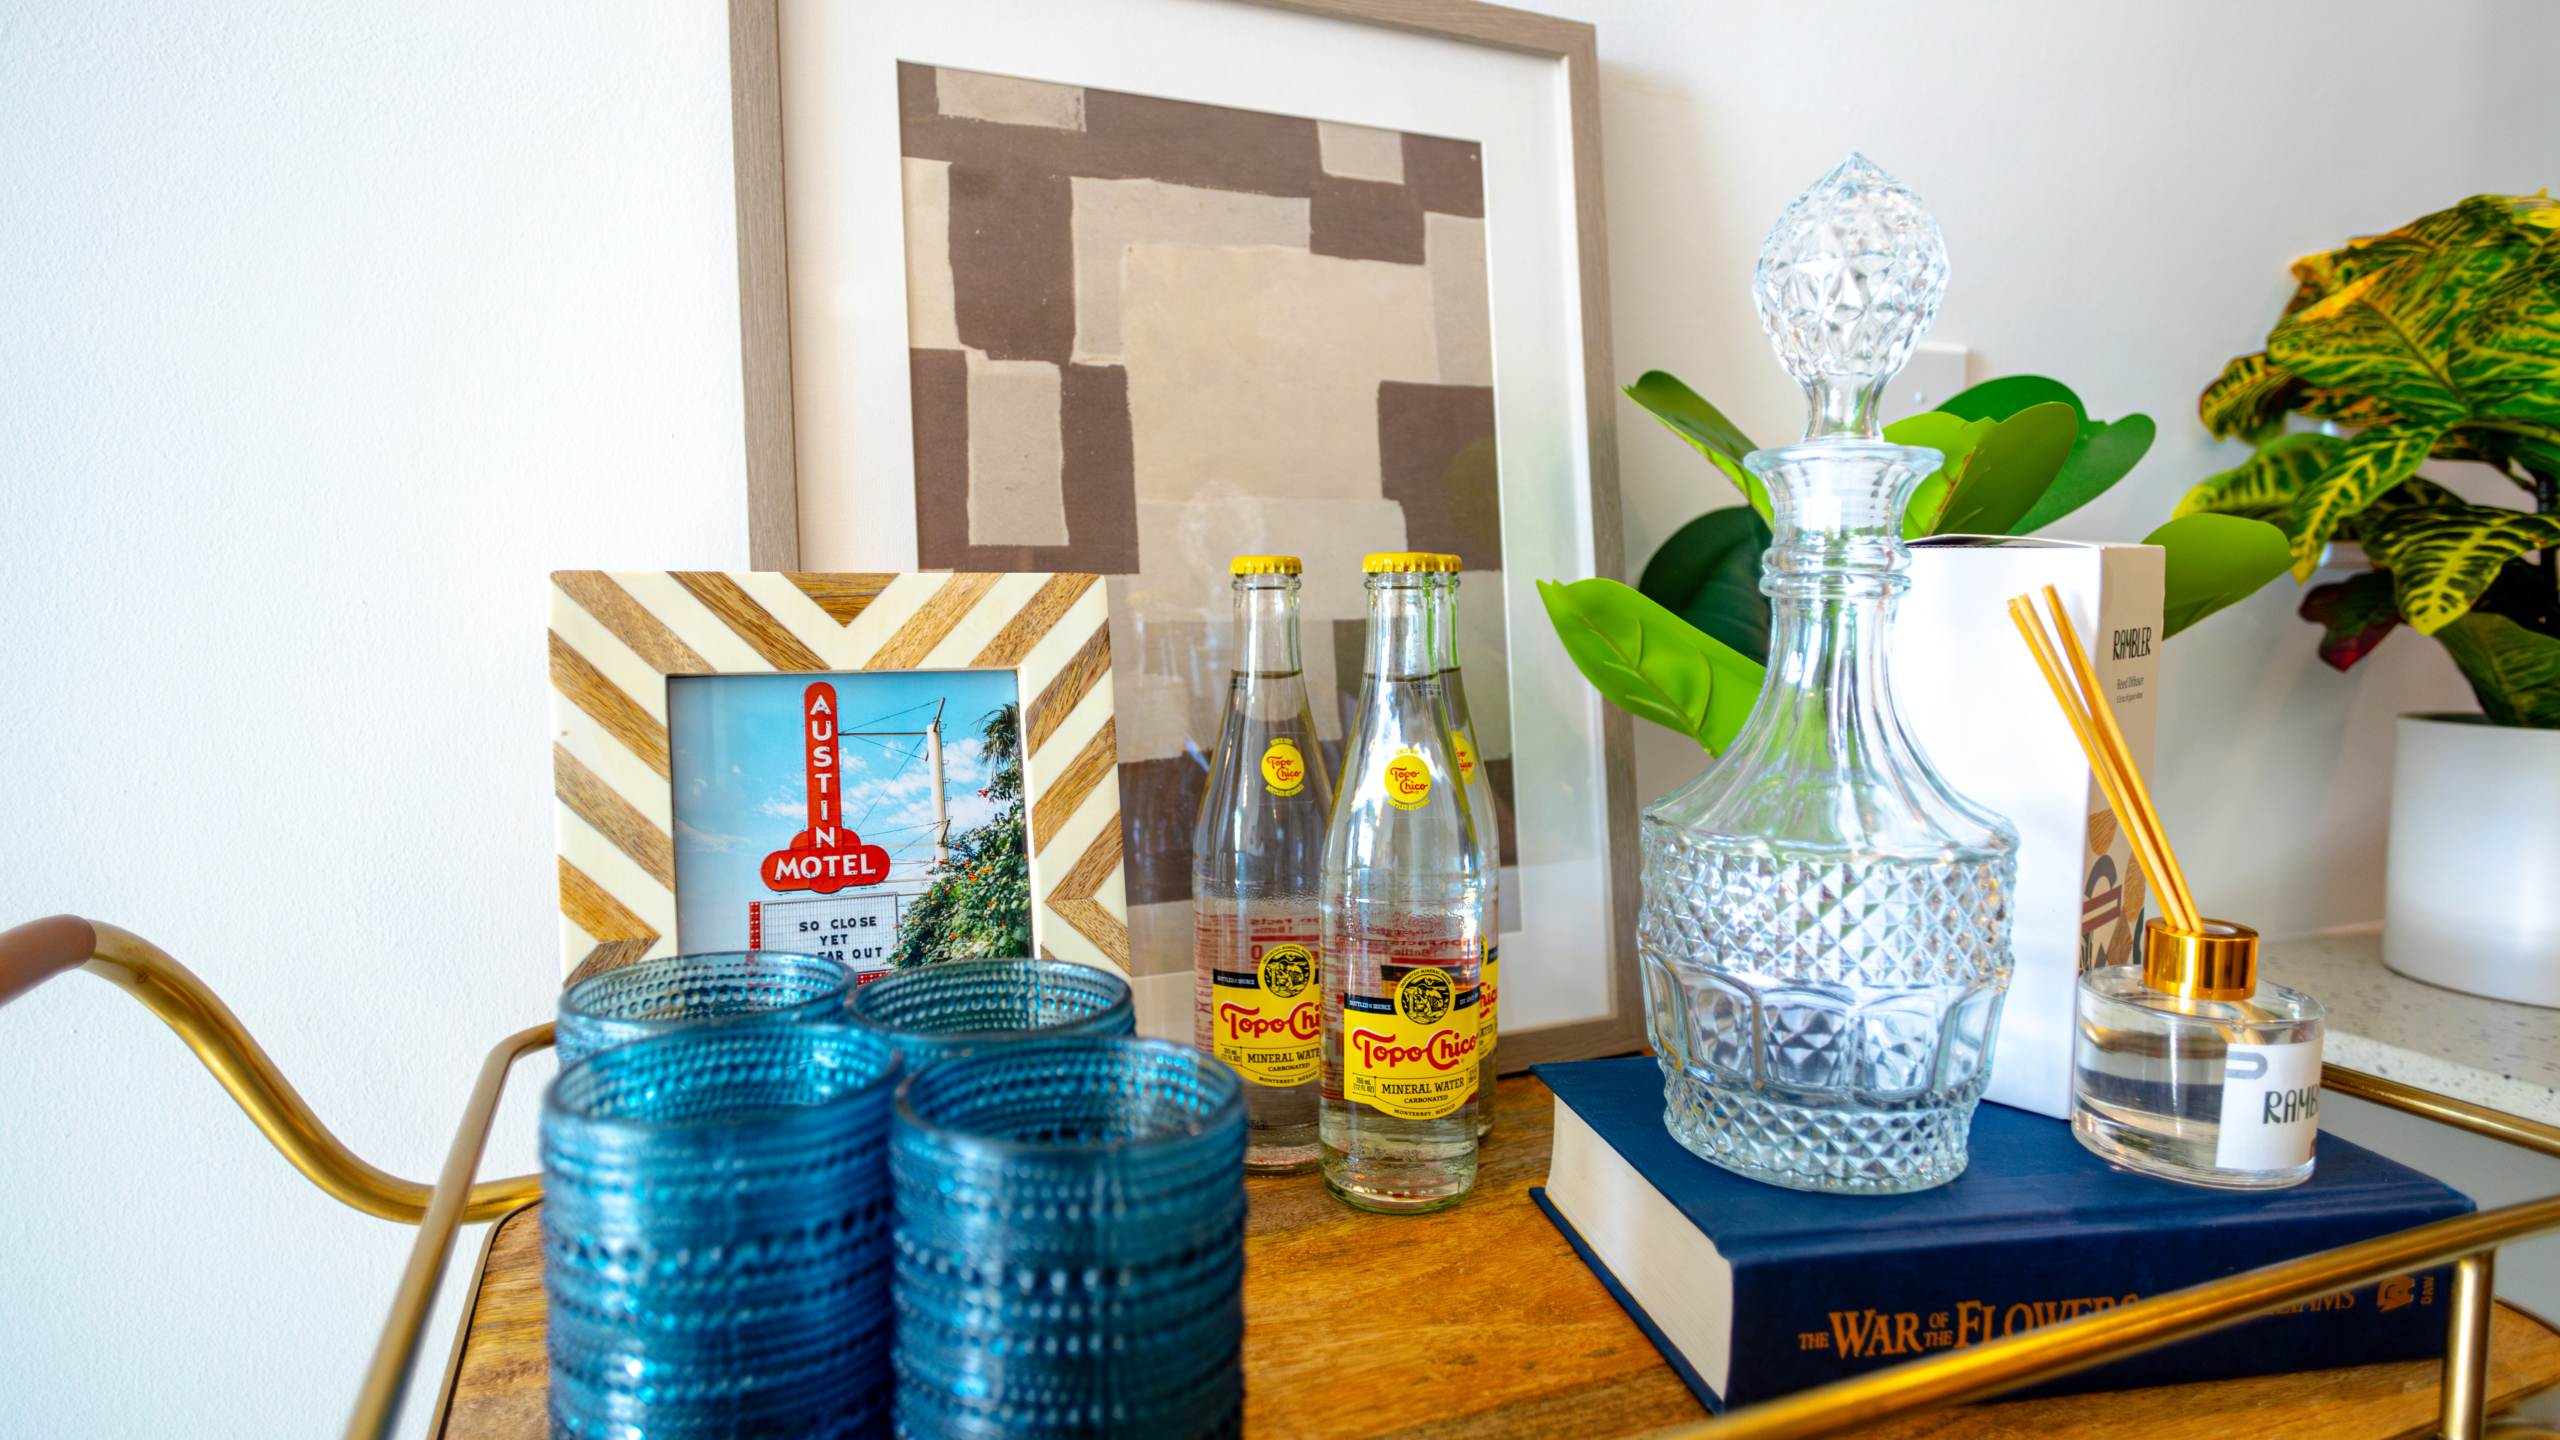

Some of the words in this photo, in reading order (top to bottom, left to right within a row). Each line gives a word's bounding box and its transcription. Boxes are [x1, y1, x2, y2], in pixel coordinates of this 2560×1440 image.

[2113, 626, 2151, 661] RAMBLER
[809, 694, 836, 848] AUSTIN
[1266, 755, 1294, 770] Topo
[1276, 766, 1302, 782] Chico
[1389, 766, 1420, 782] Topo
[1399, 778, 1429, 795] Chico
[774, 852, 877, 883] MOTEL
[799, 920, 820, 932] SO
[830, 916, 877, 930] CLOSE
[819, 933, 848, 946] YET
[852, 946, 882, 960] OUT
[1372, 1003, 1392, 1011] SOURCE
[1220, 1000, 1285, 1040] Topo
[1352, 1026, 1424, 1069] Topo
[1425, 1028, 1479, 1071] Chico
[1247, 1052, 1295, 1064] MINERAL
[1268, 1062, 1311, 1073] CARBONATED
[1258, 1076, 1297, 1084] MONTERREY,
[1381, 1083, 1433, 1095] MINERAL
[1434, 1076, 1465, 1093] WATER
[1403, 1094, 1449, 1104] CARBONATED
[1393, 1108, 1434, 1117] MONTERREY,
[1435, 1103, 1456, 1115] MÉXICO
[2420, 1276, 2435, 1305] DAW
[1929, 1311, 1949, 1330] OF
[1954, 1293, 2140, 1349] FLOW
[1799, 1332, 1829, 1350] THE
[1828, 1309, 1924, 1359] WAR
[1924, 1330, 1953, 1348] THE
